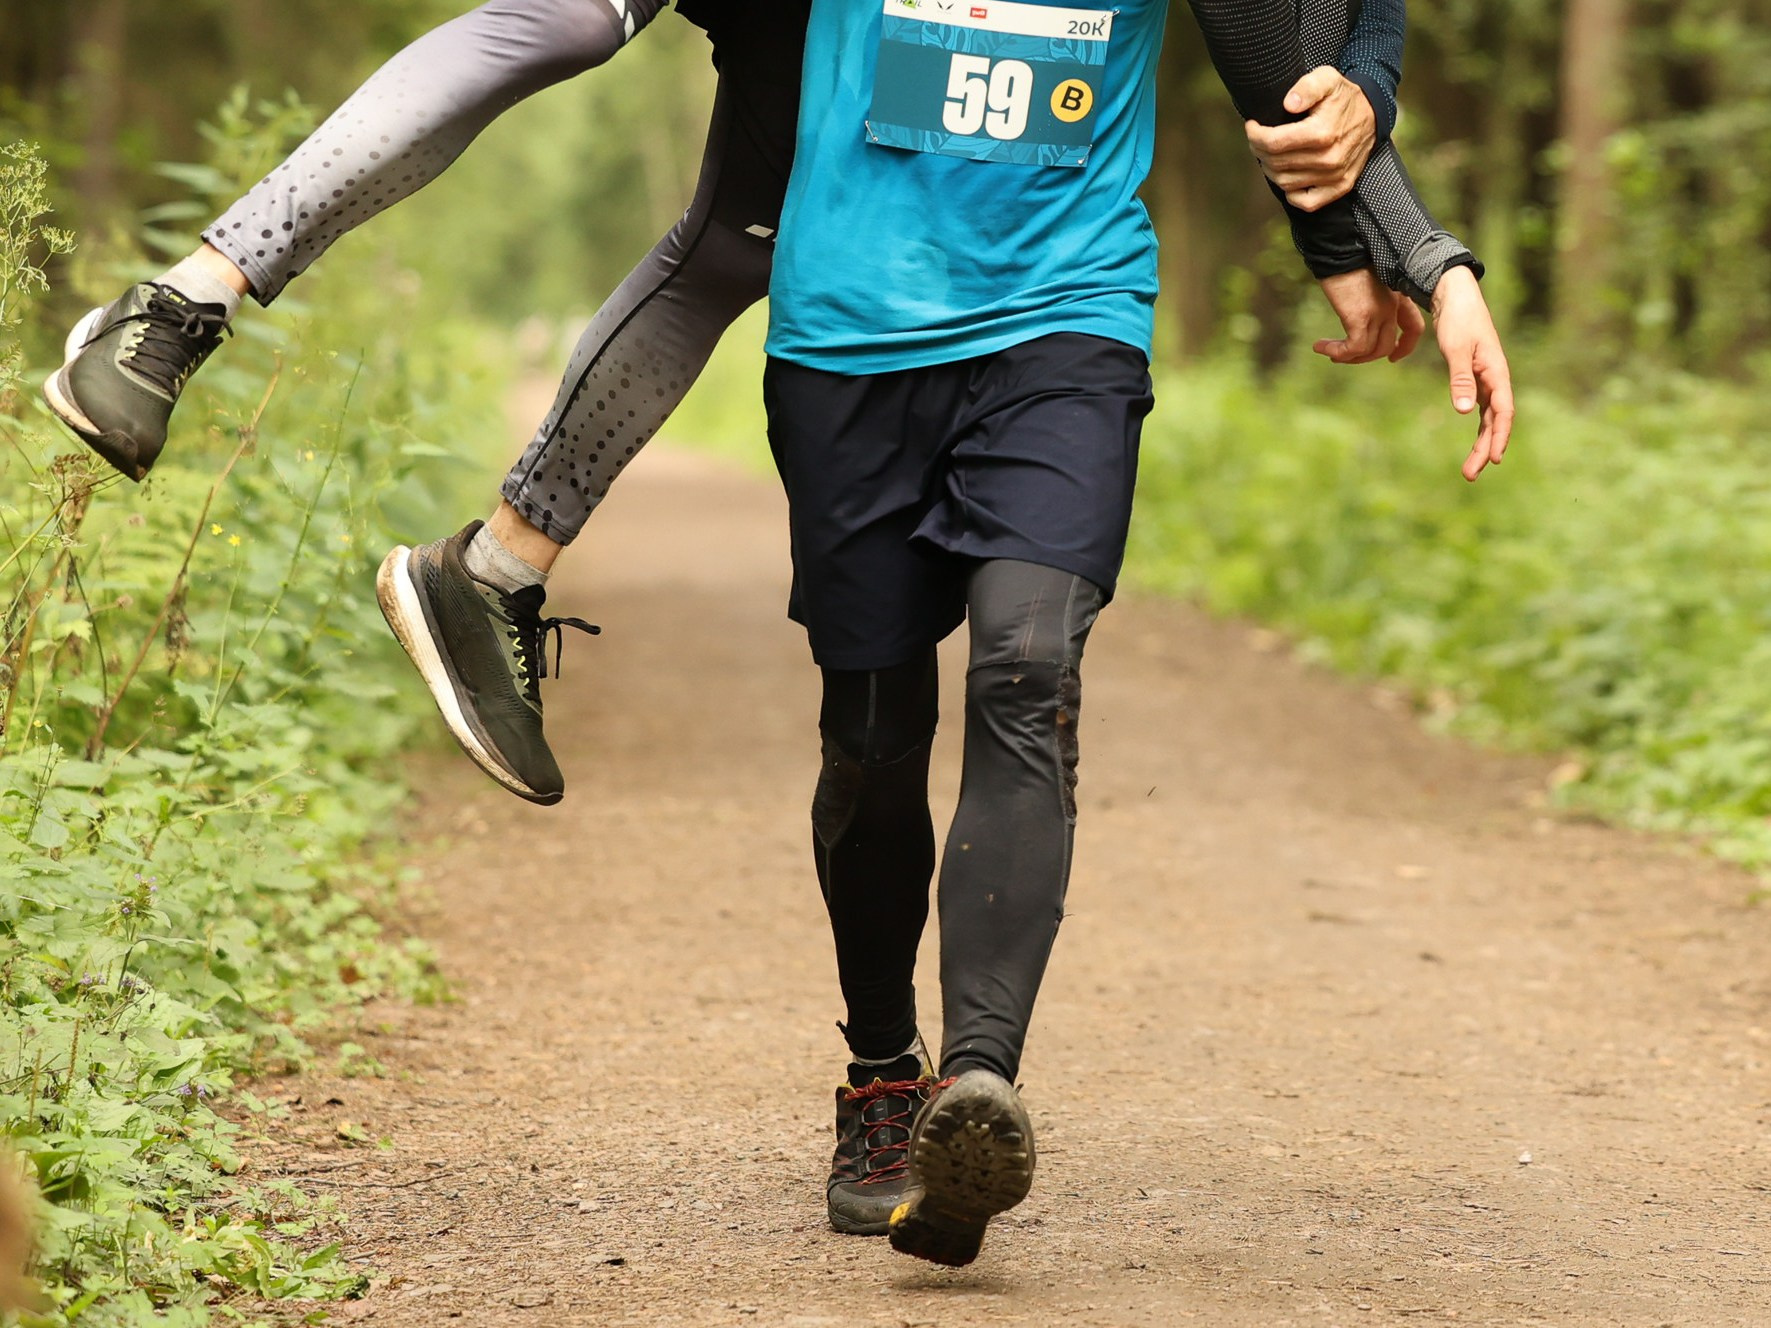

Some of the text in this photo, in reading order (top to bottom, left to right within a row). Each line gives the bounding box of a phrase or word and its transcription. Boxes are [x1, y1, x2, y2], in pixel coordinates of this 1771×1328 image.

[1067, 19, 1106, 37] 20K
[942, 52, 1035, 141] 59
[1060, 85, 1085, 112] B
